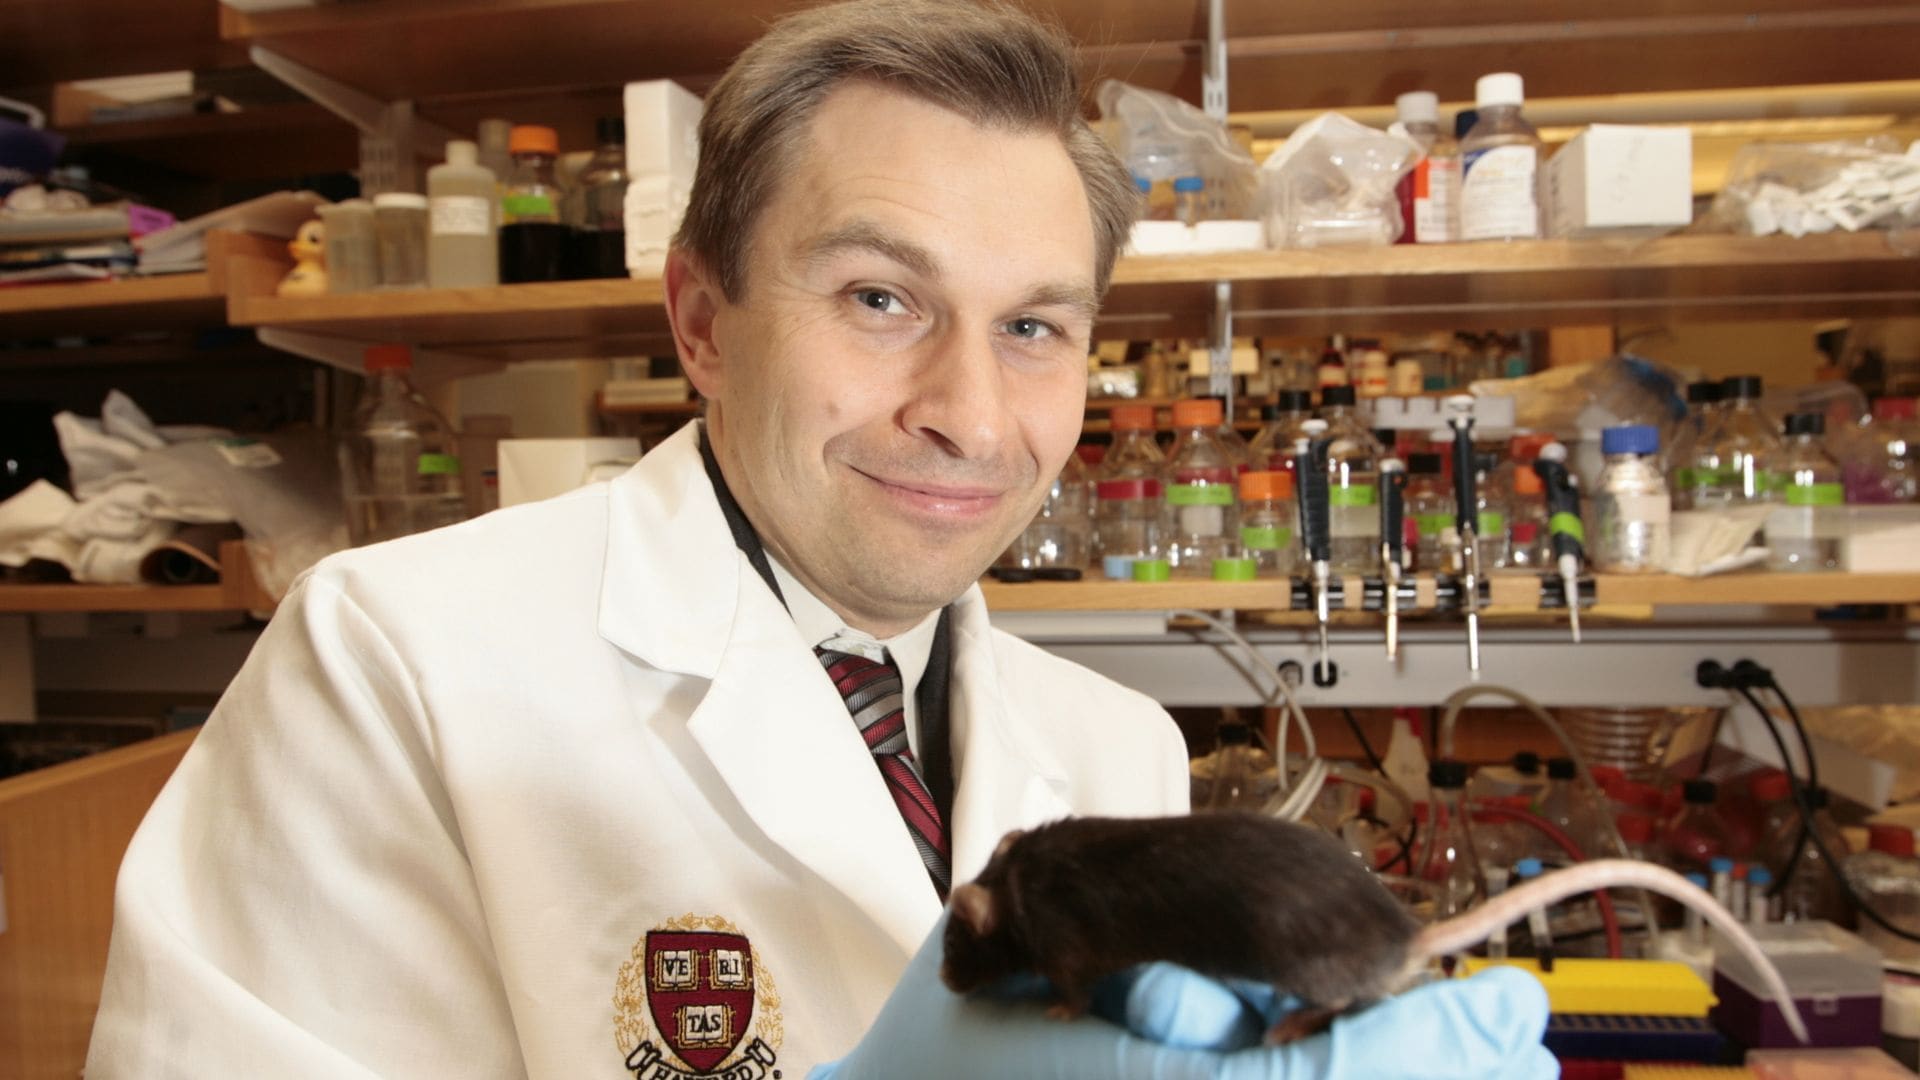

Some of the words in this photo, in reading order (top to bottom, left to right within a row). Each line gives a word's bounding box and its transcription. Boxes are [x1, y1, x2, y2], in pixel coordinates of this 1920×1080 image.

[664, 959, 689, 976] VE
[719, 959, 740, 975] RI
[687, 1014, 721, 1033] TAS
